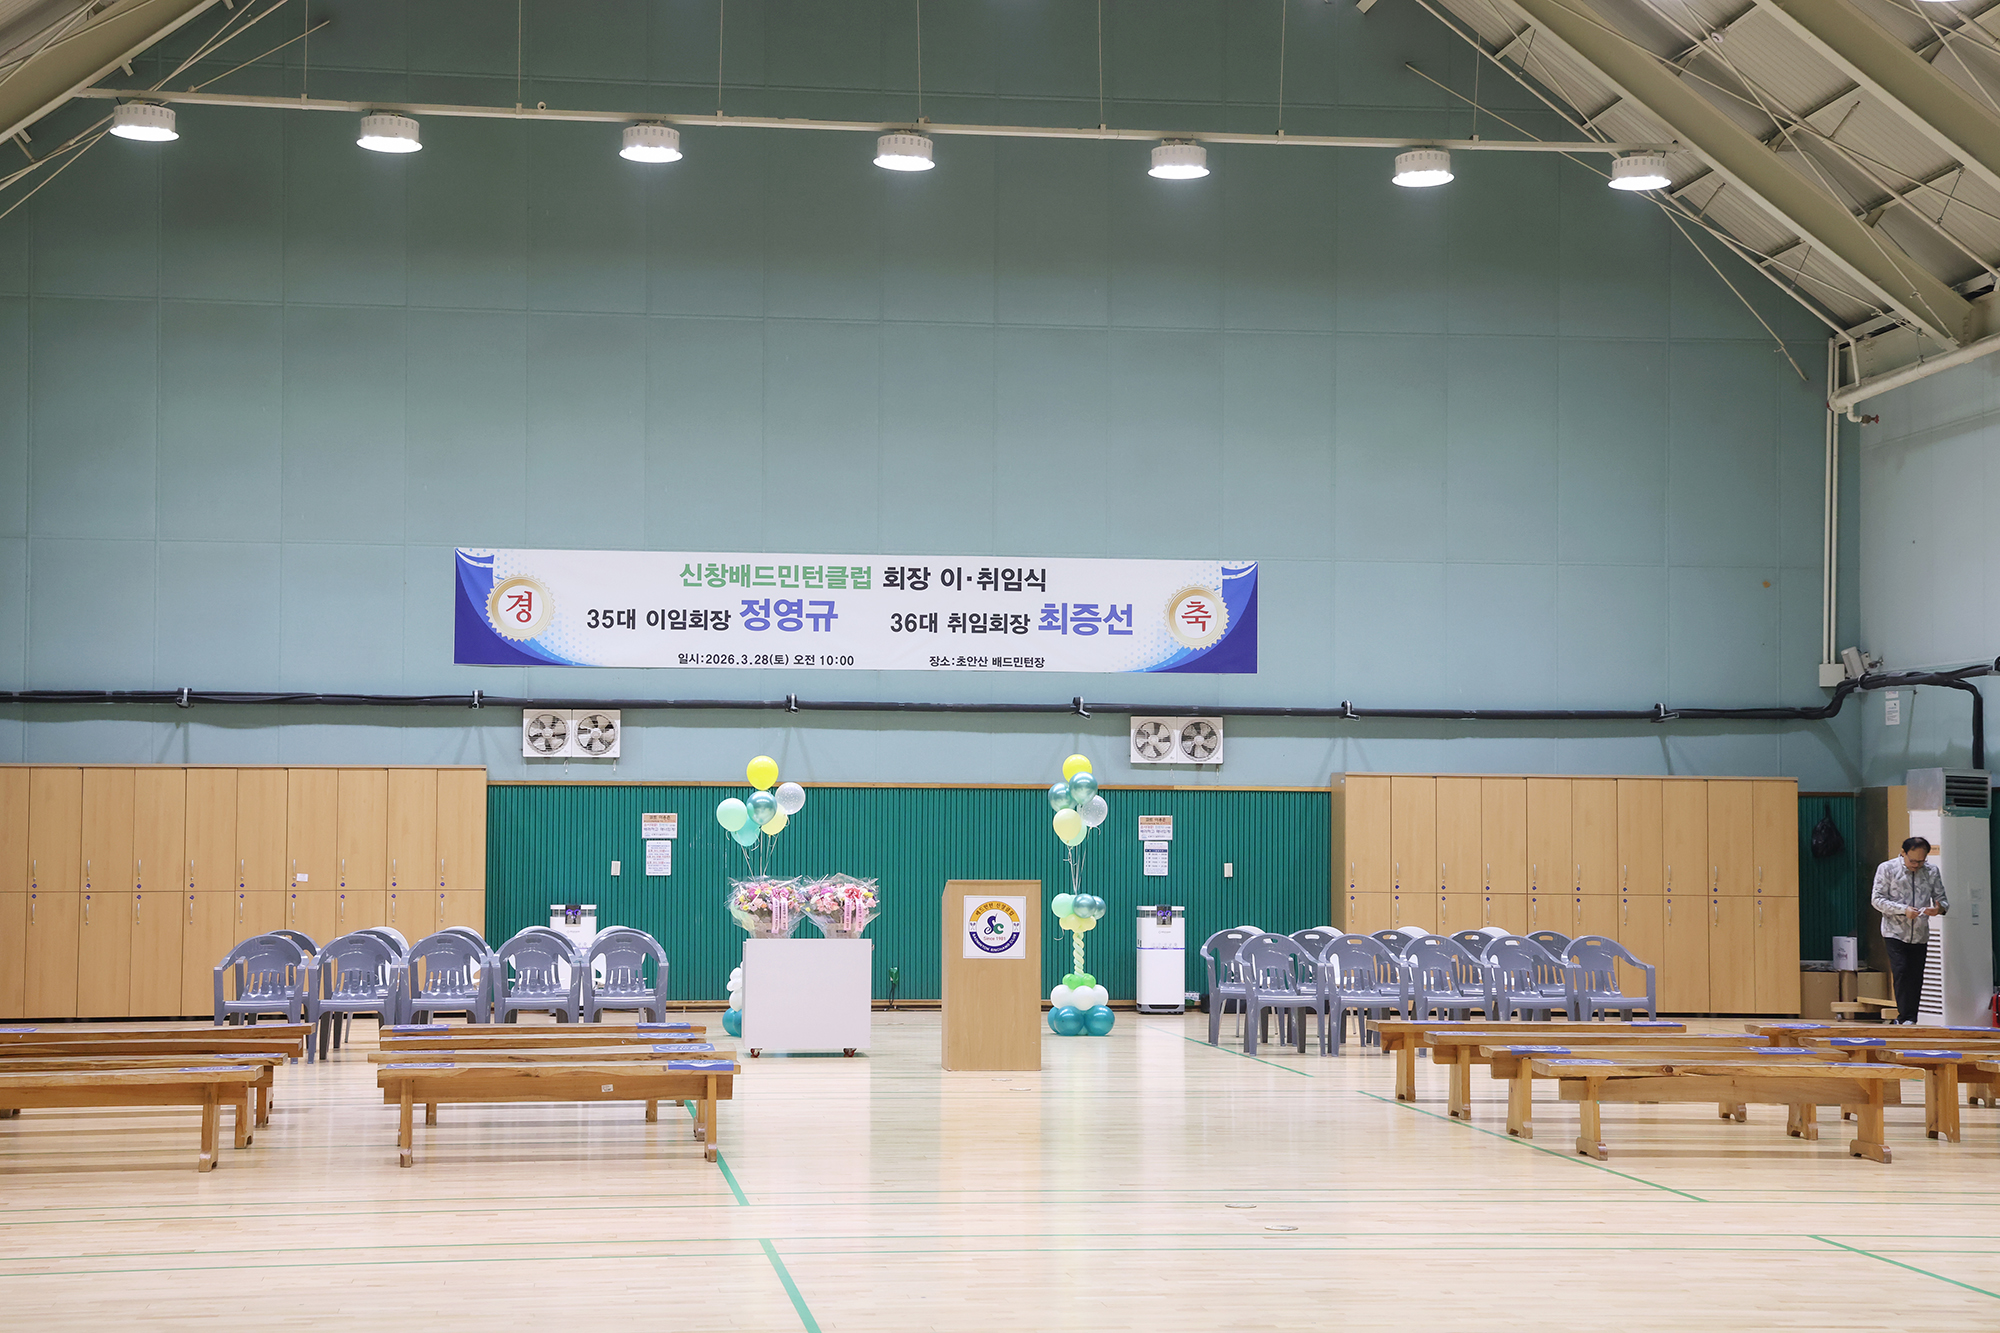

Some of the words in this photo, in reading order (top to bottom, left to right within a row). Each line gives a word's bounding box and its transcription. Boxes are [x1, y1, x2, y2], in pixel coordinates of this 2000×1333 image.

[679, 562, 873, 590] 신창배드민턴클럽
[882, 566, 932, 592] 회장
[505, 590, 534, 624] 경
[586, 608, 637, 631] 35대
[645, 608, 732, 632] 이임회장
[738, 597, 840, 634] 정영규
[890, 612, 939, 635] 36대
[946, 612, 1032, 635] 취임회장
[1036, 602, 1135, 637] 최증선
[1180, 600, 1213, 633] 축
[677, 652, 790, 667] 일시:2026.3.28(토)
[793, 653, 816, 667] 오전
[819, 655, 855, 667] 10:00
[928, 655, 989, 669] 장소:초안산
[991, 656, 1046, 670] 배드민턴장
